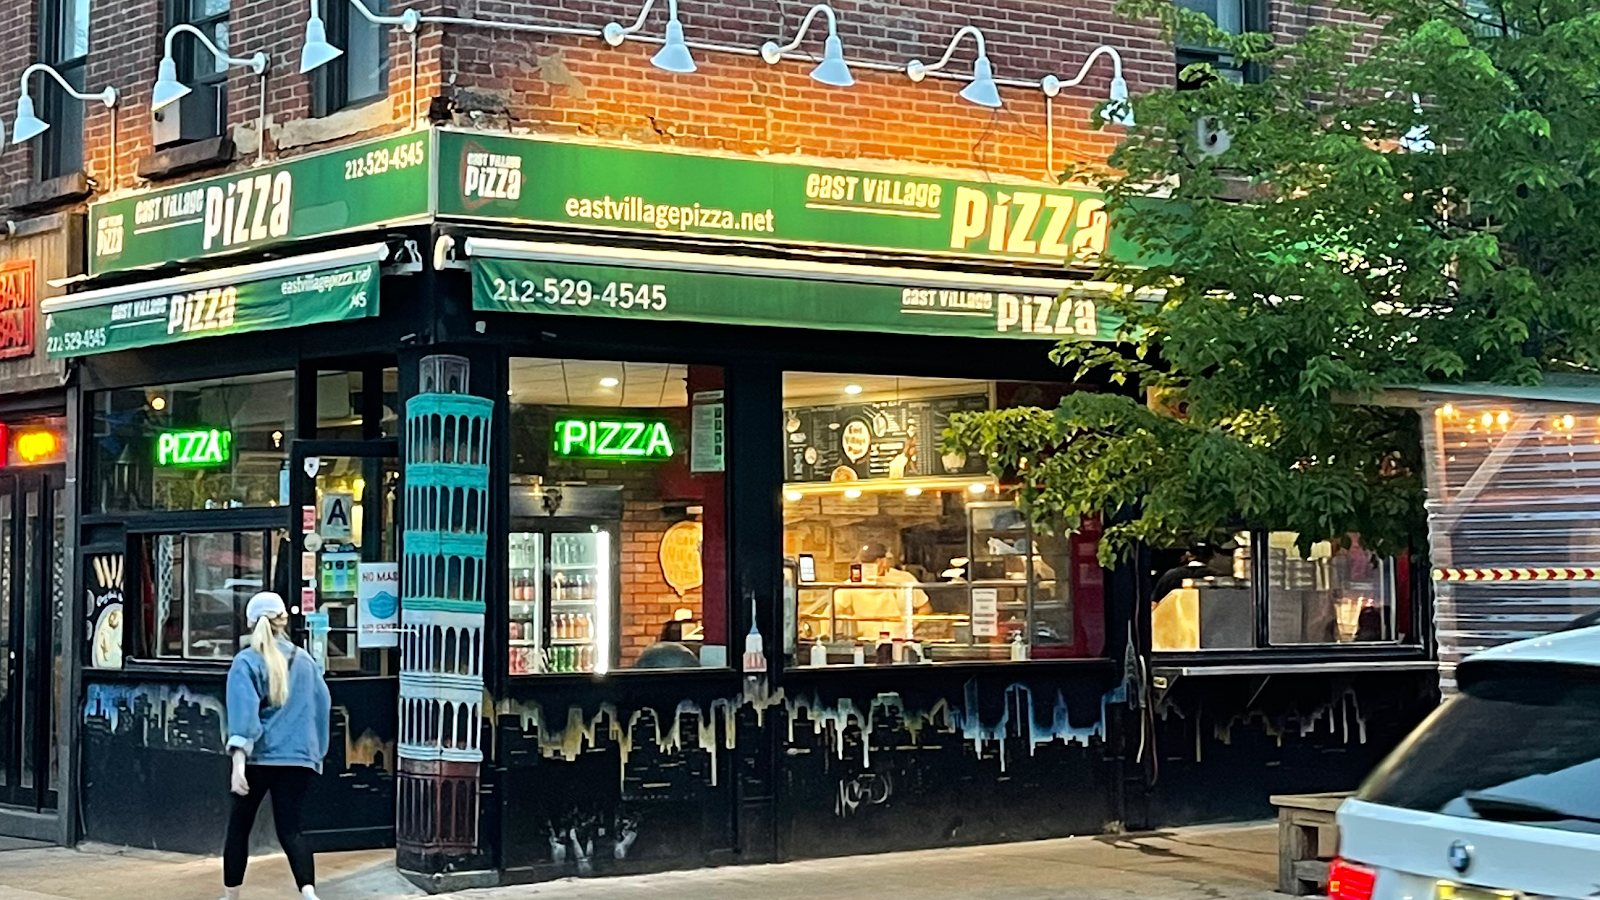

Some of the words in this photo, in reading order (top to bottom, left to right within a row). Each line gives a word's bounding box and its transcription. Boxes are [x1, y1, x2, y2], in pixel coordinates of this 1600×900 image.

[345, 140, 424, 180] 212-529-4545
[464, 165, 522, 200] pizza
[203, 171, 292, 250] pizza
[565, 195, 775, 233] eastvillagepizza.net
[950, 186, 1109, 259] pizza
[167, 286, 238, 335] pizza
[492, 277, 668, 312] 212-529-4545
[997, 292, 1098, 336] pizza
[158, 428, 224, 466] PIZZA
[561, 420, 675, 457] PIZZA
[326, 498, 348, 526] A
[377, 571, 399, 582] MAS
